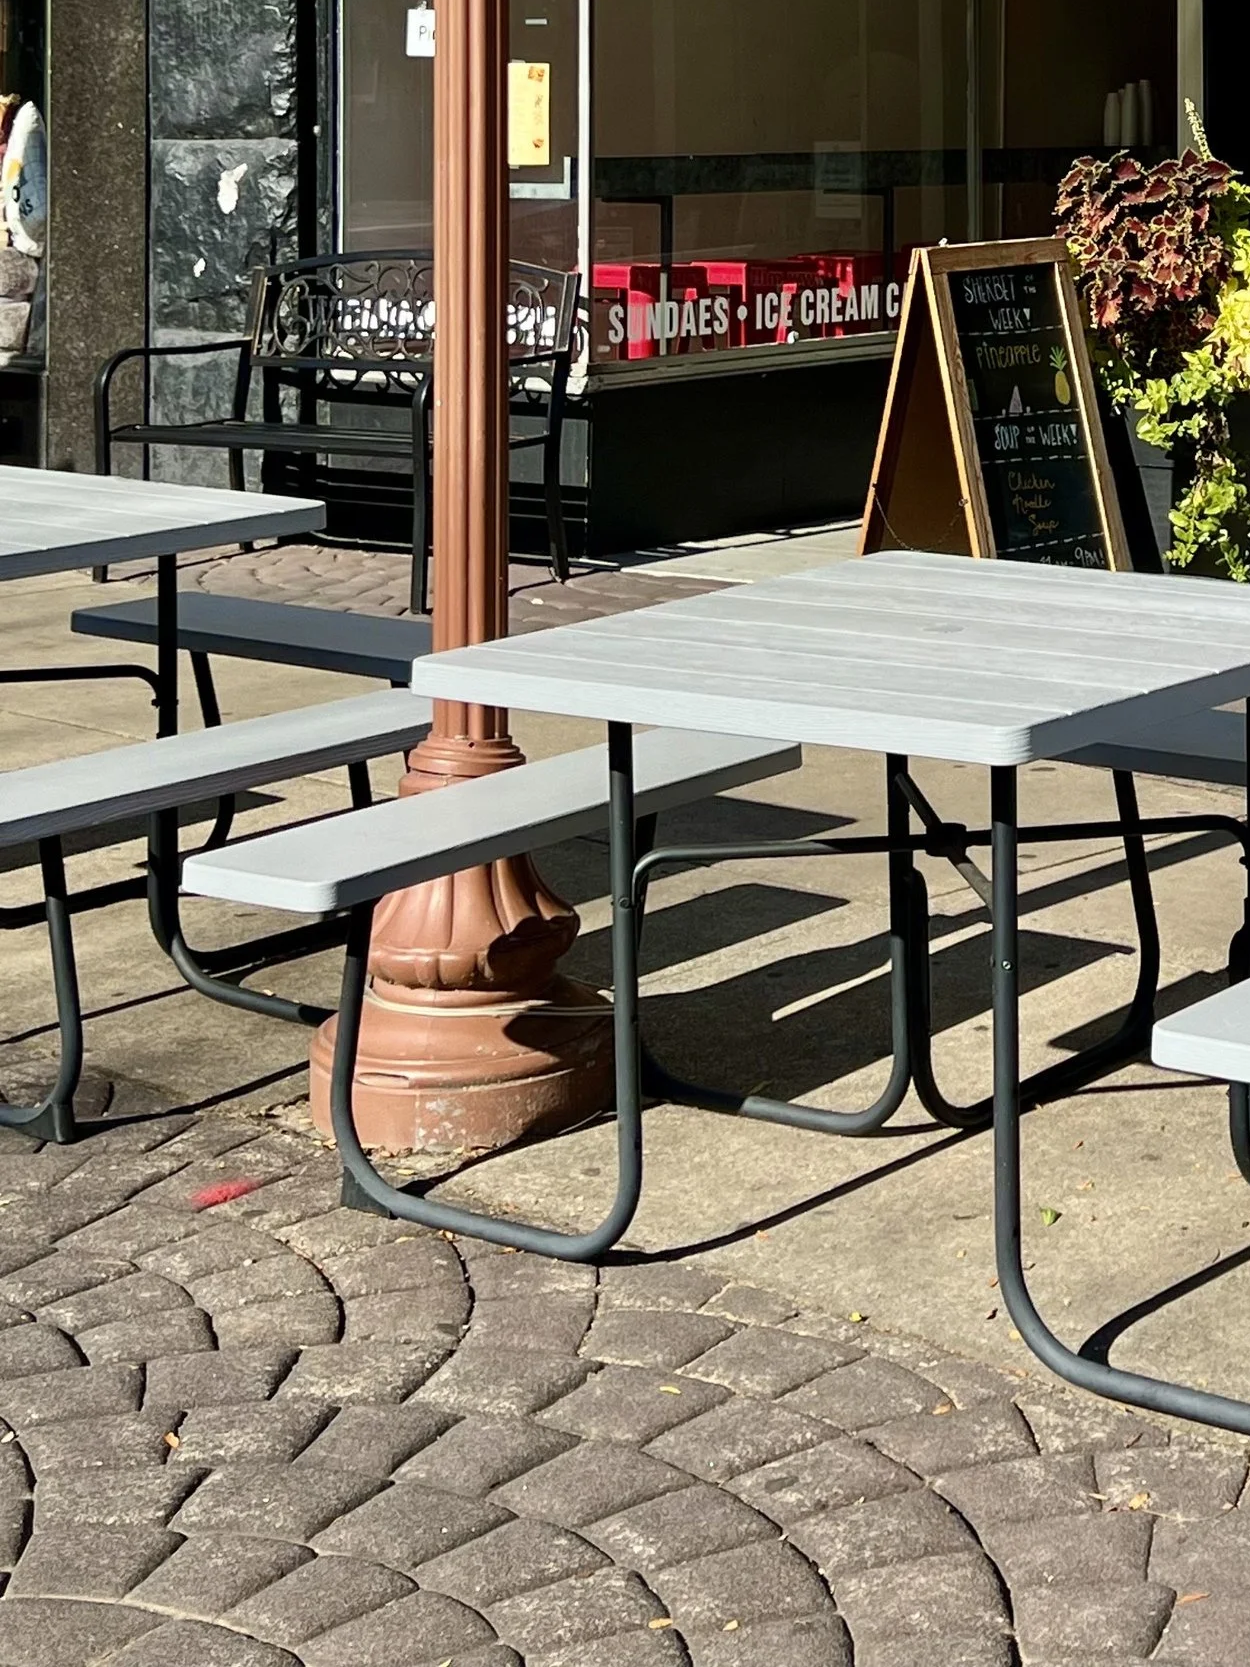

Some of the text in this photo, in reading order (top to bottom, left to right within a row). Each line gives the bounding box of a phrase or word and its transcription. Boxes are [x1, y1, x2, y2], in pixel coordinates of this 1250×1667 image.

[963, 273, 1016, 305] SHERBET
[608, 294, 730, 345] SUNDAES
[754, 291, 794, 331] ICE
[800, 283, 880, 326] CREAM
[988, 307, 1032, 331] WEEK!
[993, 422, 1020, 451] SOUP
[1038, 423, 1079, 447] WEEK!
[1007, 470, 1056, 492] Chicken
